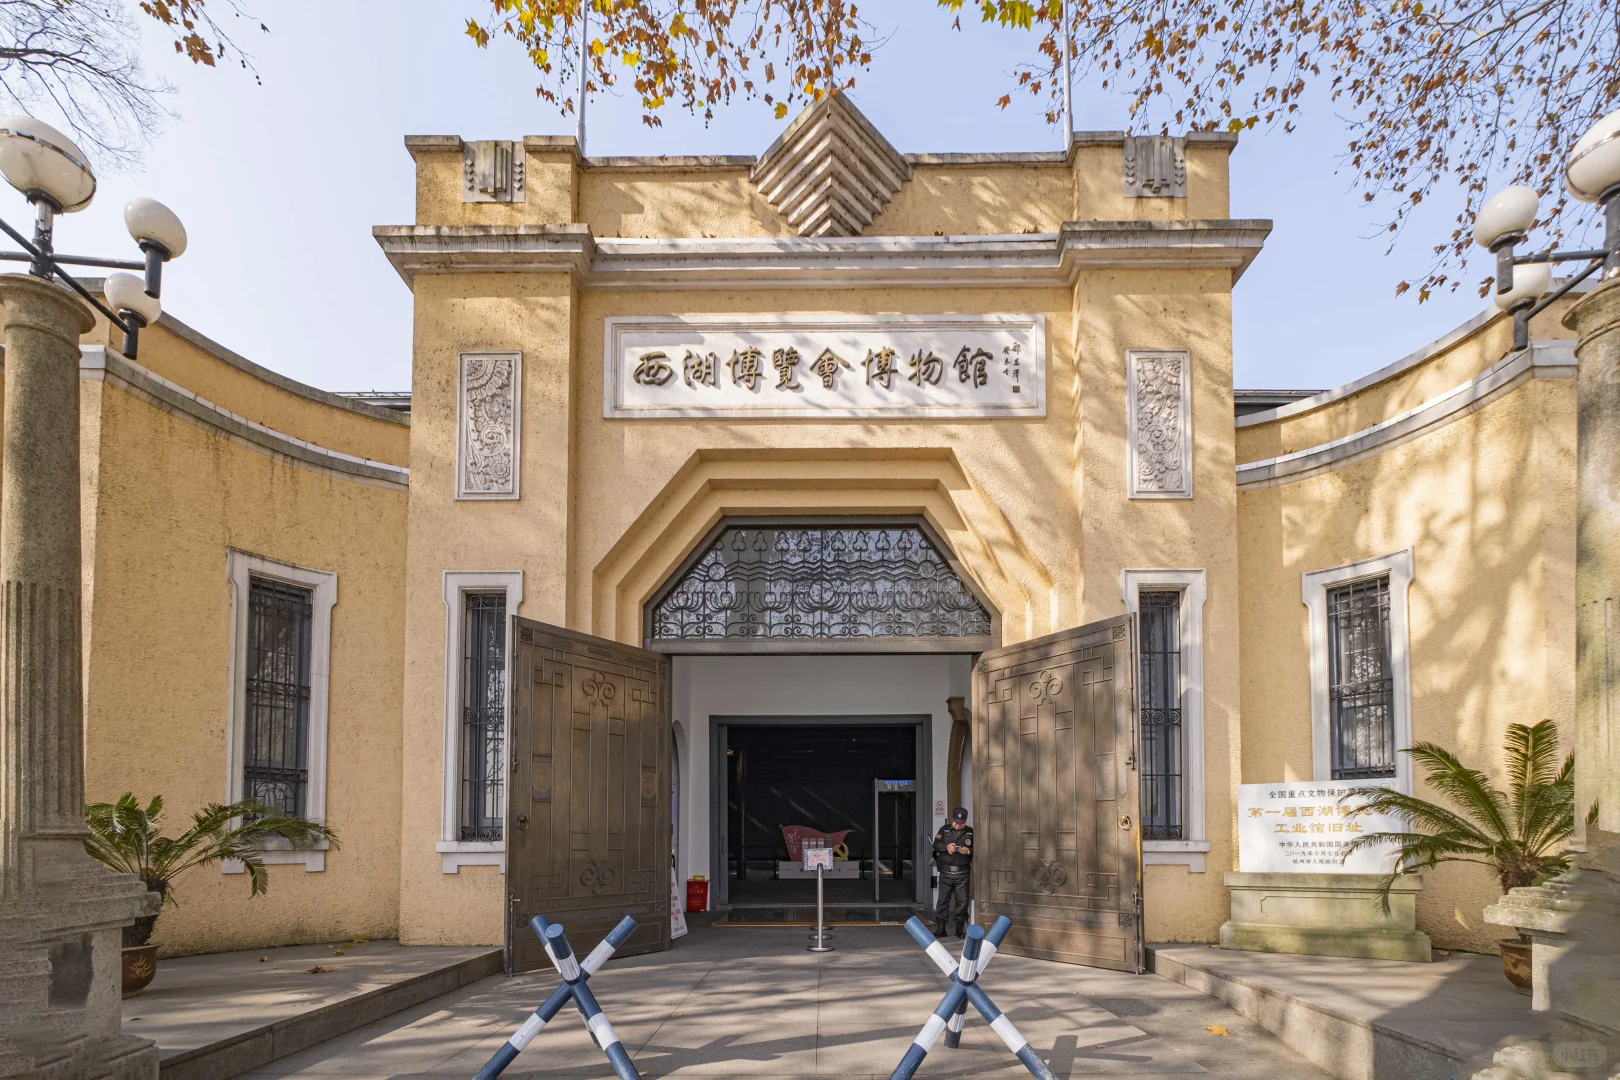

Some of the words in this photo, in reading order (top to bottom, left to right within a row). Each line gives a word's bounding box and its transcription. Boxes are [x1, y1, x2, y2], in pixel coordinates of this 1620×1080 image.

[633, 344, 995, 390] 西湖博覽會博物館
[1273, 822, 1364, 834] 工业馆旧址
[1278, 841, 1357, 849] 中华人民共和国国务
